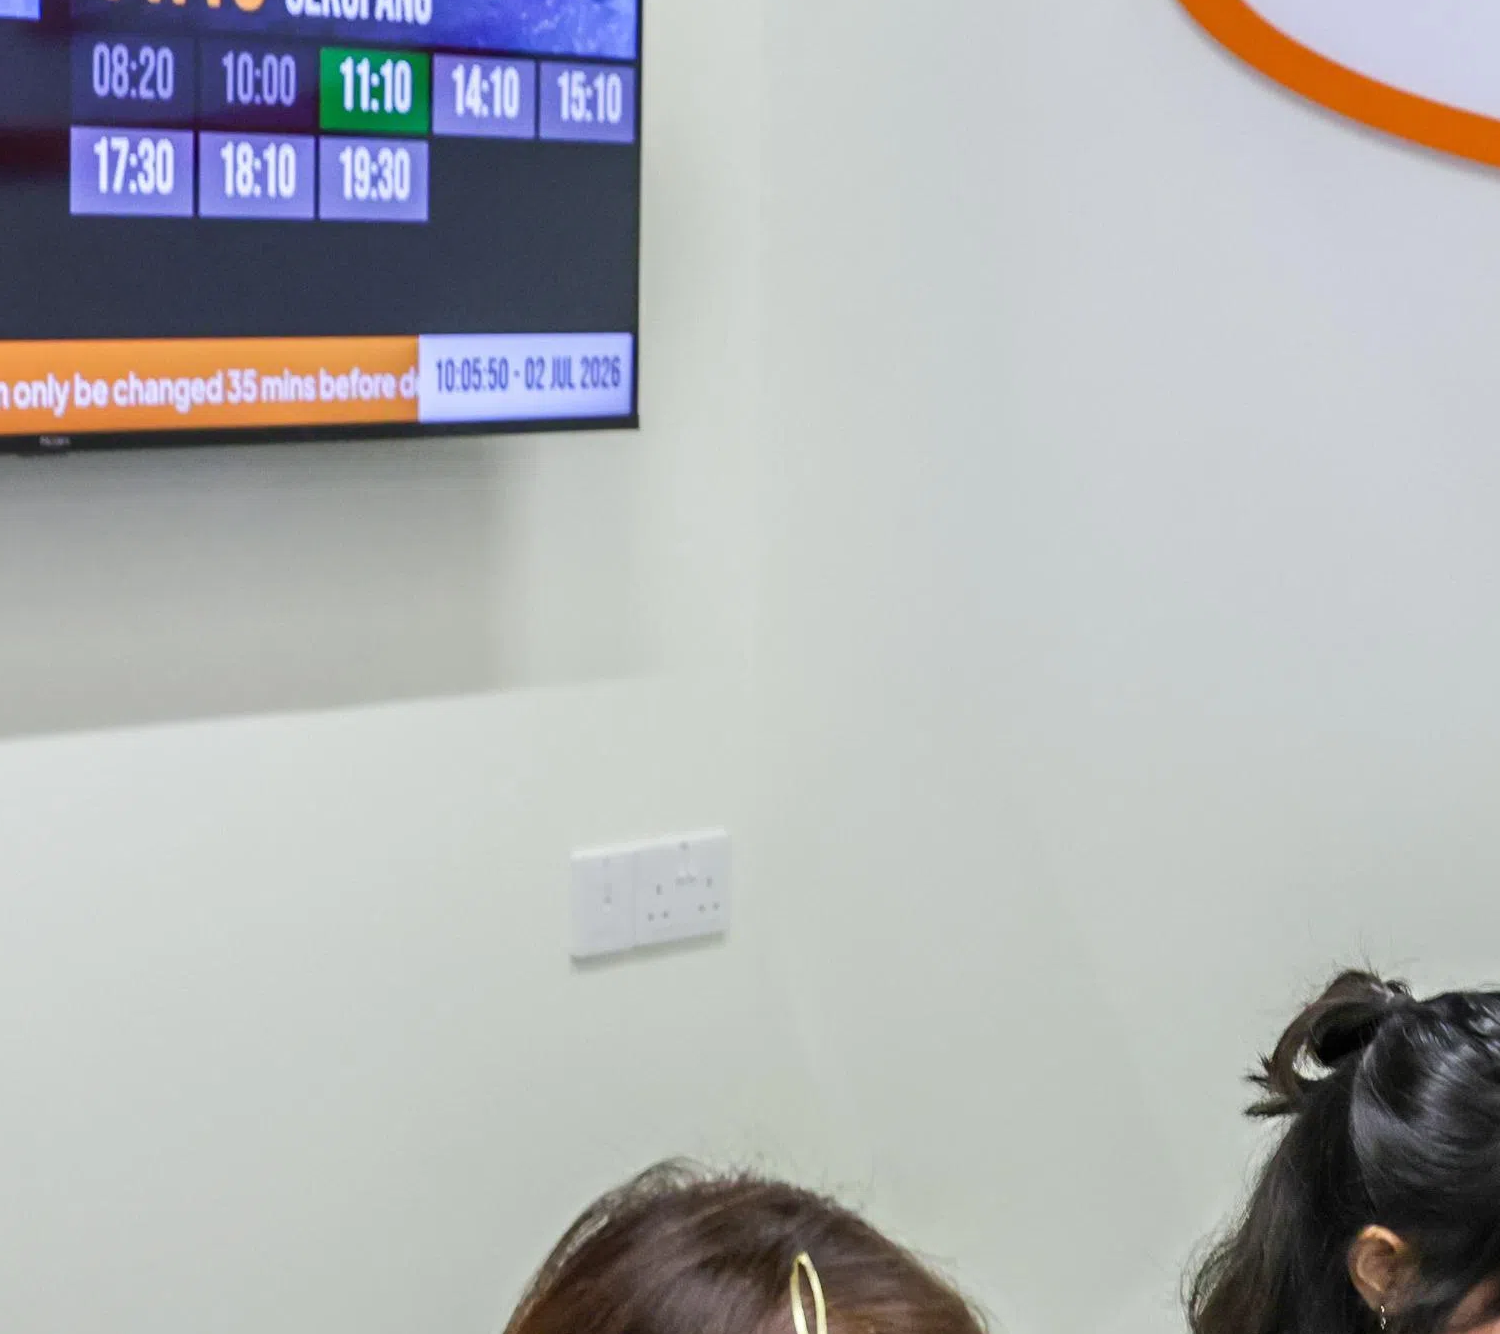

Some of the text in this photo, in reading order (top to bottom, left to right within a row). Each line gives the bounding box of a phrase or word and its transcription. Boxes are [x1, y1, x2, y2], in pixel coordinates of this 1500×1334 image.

[93, 43, 622, 123] 08:20 10:00 11:10 14:10 15:10
[94, 137, 410, 201] 17:30 18:10 19:30
[12, 373, 71, 417] only
[73, 372, 110, 408] be
[111, 370, 223, 414] changed
[225, 369, 258, 403] 35
[260, 369, 317, 402] mins
[318, 367, 398, 402] before
[436, 357, 509, 392] 10:05:50
[525, 356, 545, 390] 02
[550, 356, 575, 390] JUL
[580, 355, 621, 389] 2026
